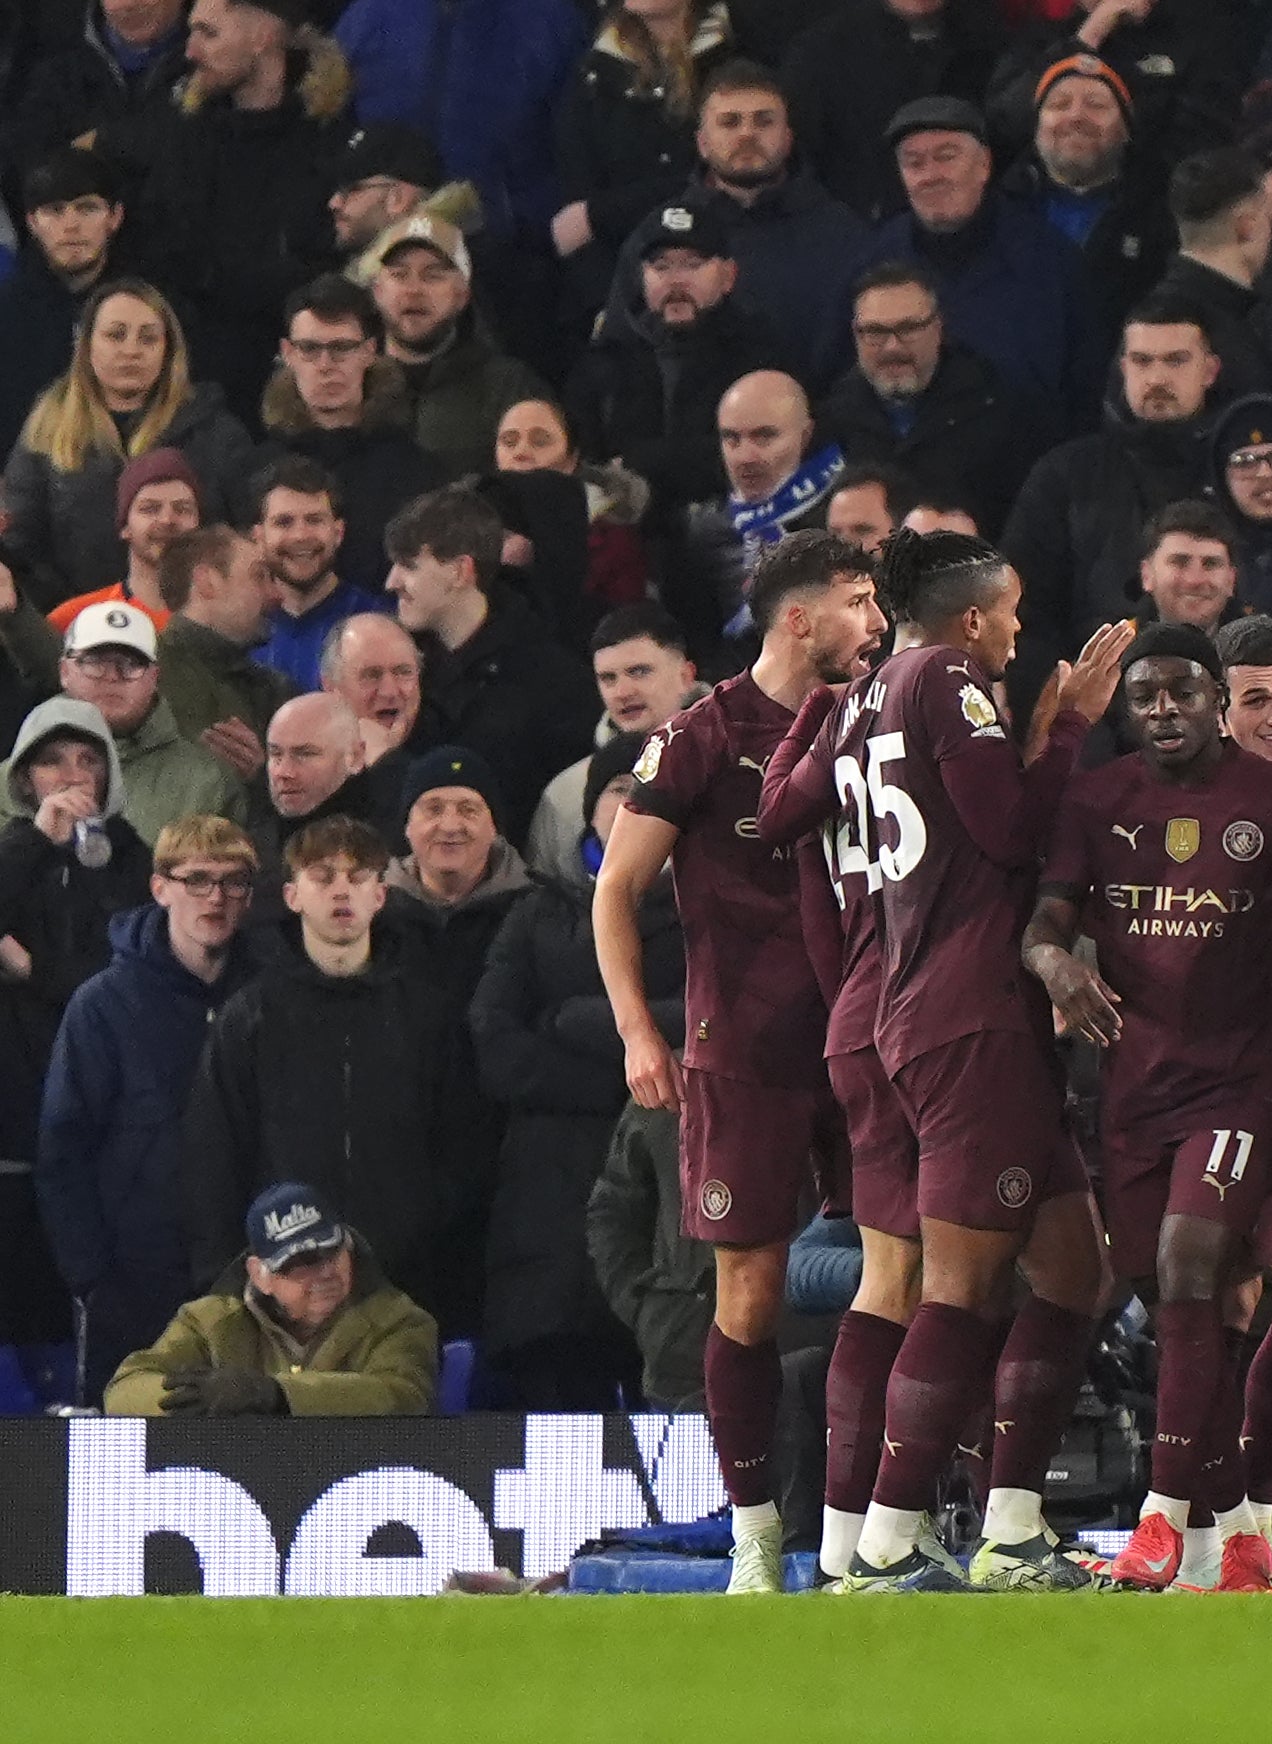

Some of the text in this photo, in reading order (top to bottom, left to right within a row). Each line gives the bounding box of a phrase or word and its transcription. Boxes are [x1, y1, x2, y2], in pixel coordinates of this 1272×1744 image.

[1105, 883, 1255, 914] ETIHAD
[1127, 917, 1225, 938] AIRWAYS
[1205, 1129, 1254, 1181] 11
[264, 1204, 321, 1241] Malta
[1157, 1432, 1192, 1447] CITY
